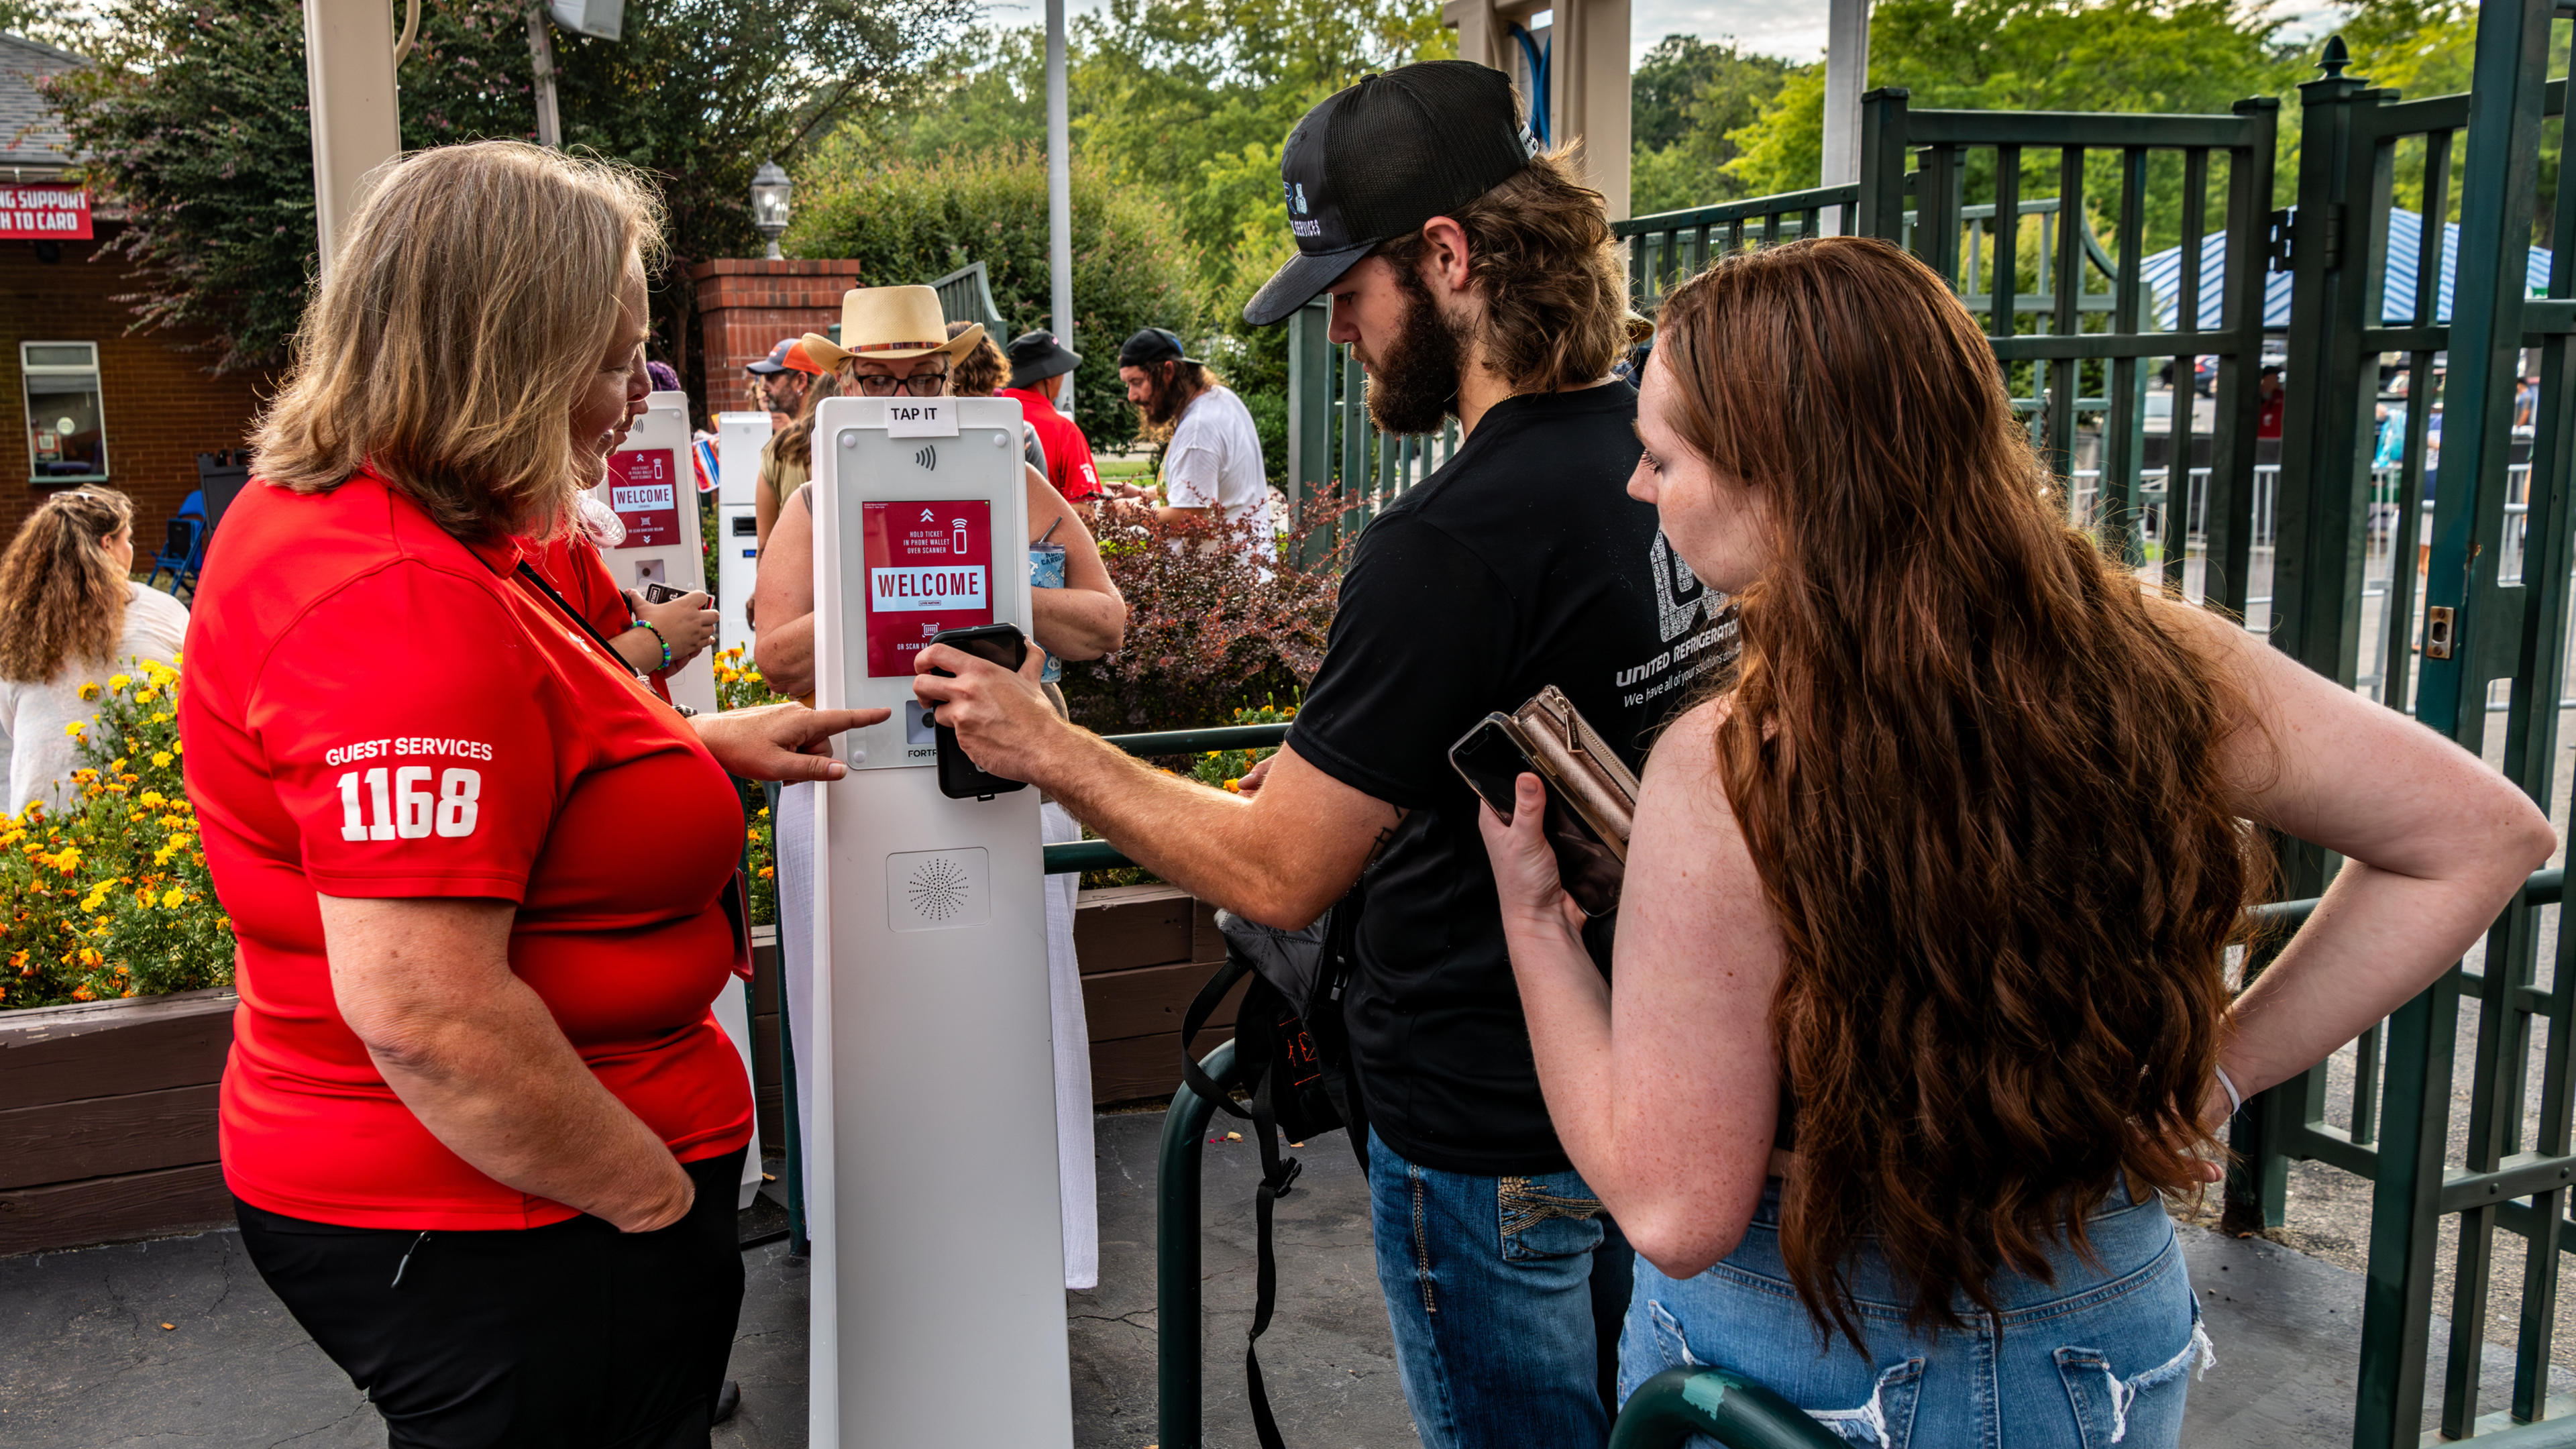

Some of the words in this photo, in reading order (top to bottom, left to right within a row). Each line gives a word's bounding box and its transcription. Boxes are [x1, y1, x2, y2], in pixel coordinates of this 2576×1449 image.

[17, 191, 86, 209] SUPPORT
[13, 211, 34, 230] TO
[36, 211, 78, 230] CARD
[891, 407, 920, 421] TAP
[924, 407, 937, 420] IT
[616, 488, 669, 504] WELCOME
[877, 572, 978, 597] WELCOME
[1045, 571, 1059, 584] UNC
[1616, 651, 1670, 688] UNITED
[1624, 692, 1644, 708] We
[1646, 684, 1664, 702] have
[1664, 675, 1673, 692] all
[1674, 671, 1682, 687] of
[1681, 666, 1695, 687] your
[1695, 653, 1722, 675] solutions
[325, 739, 391, 767] GUEST
[394, 737, 492, 761] SERVICES
[908, 749, 937, 757] FORTR
[336, 765, 481, 842] 1168
